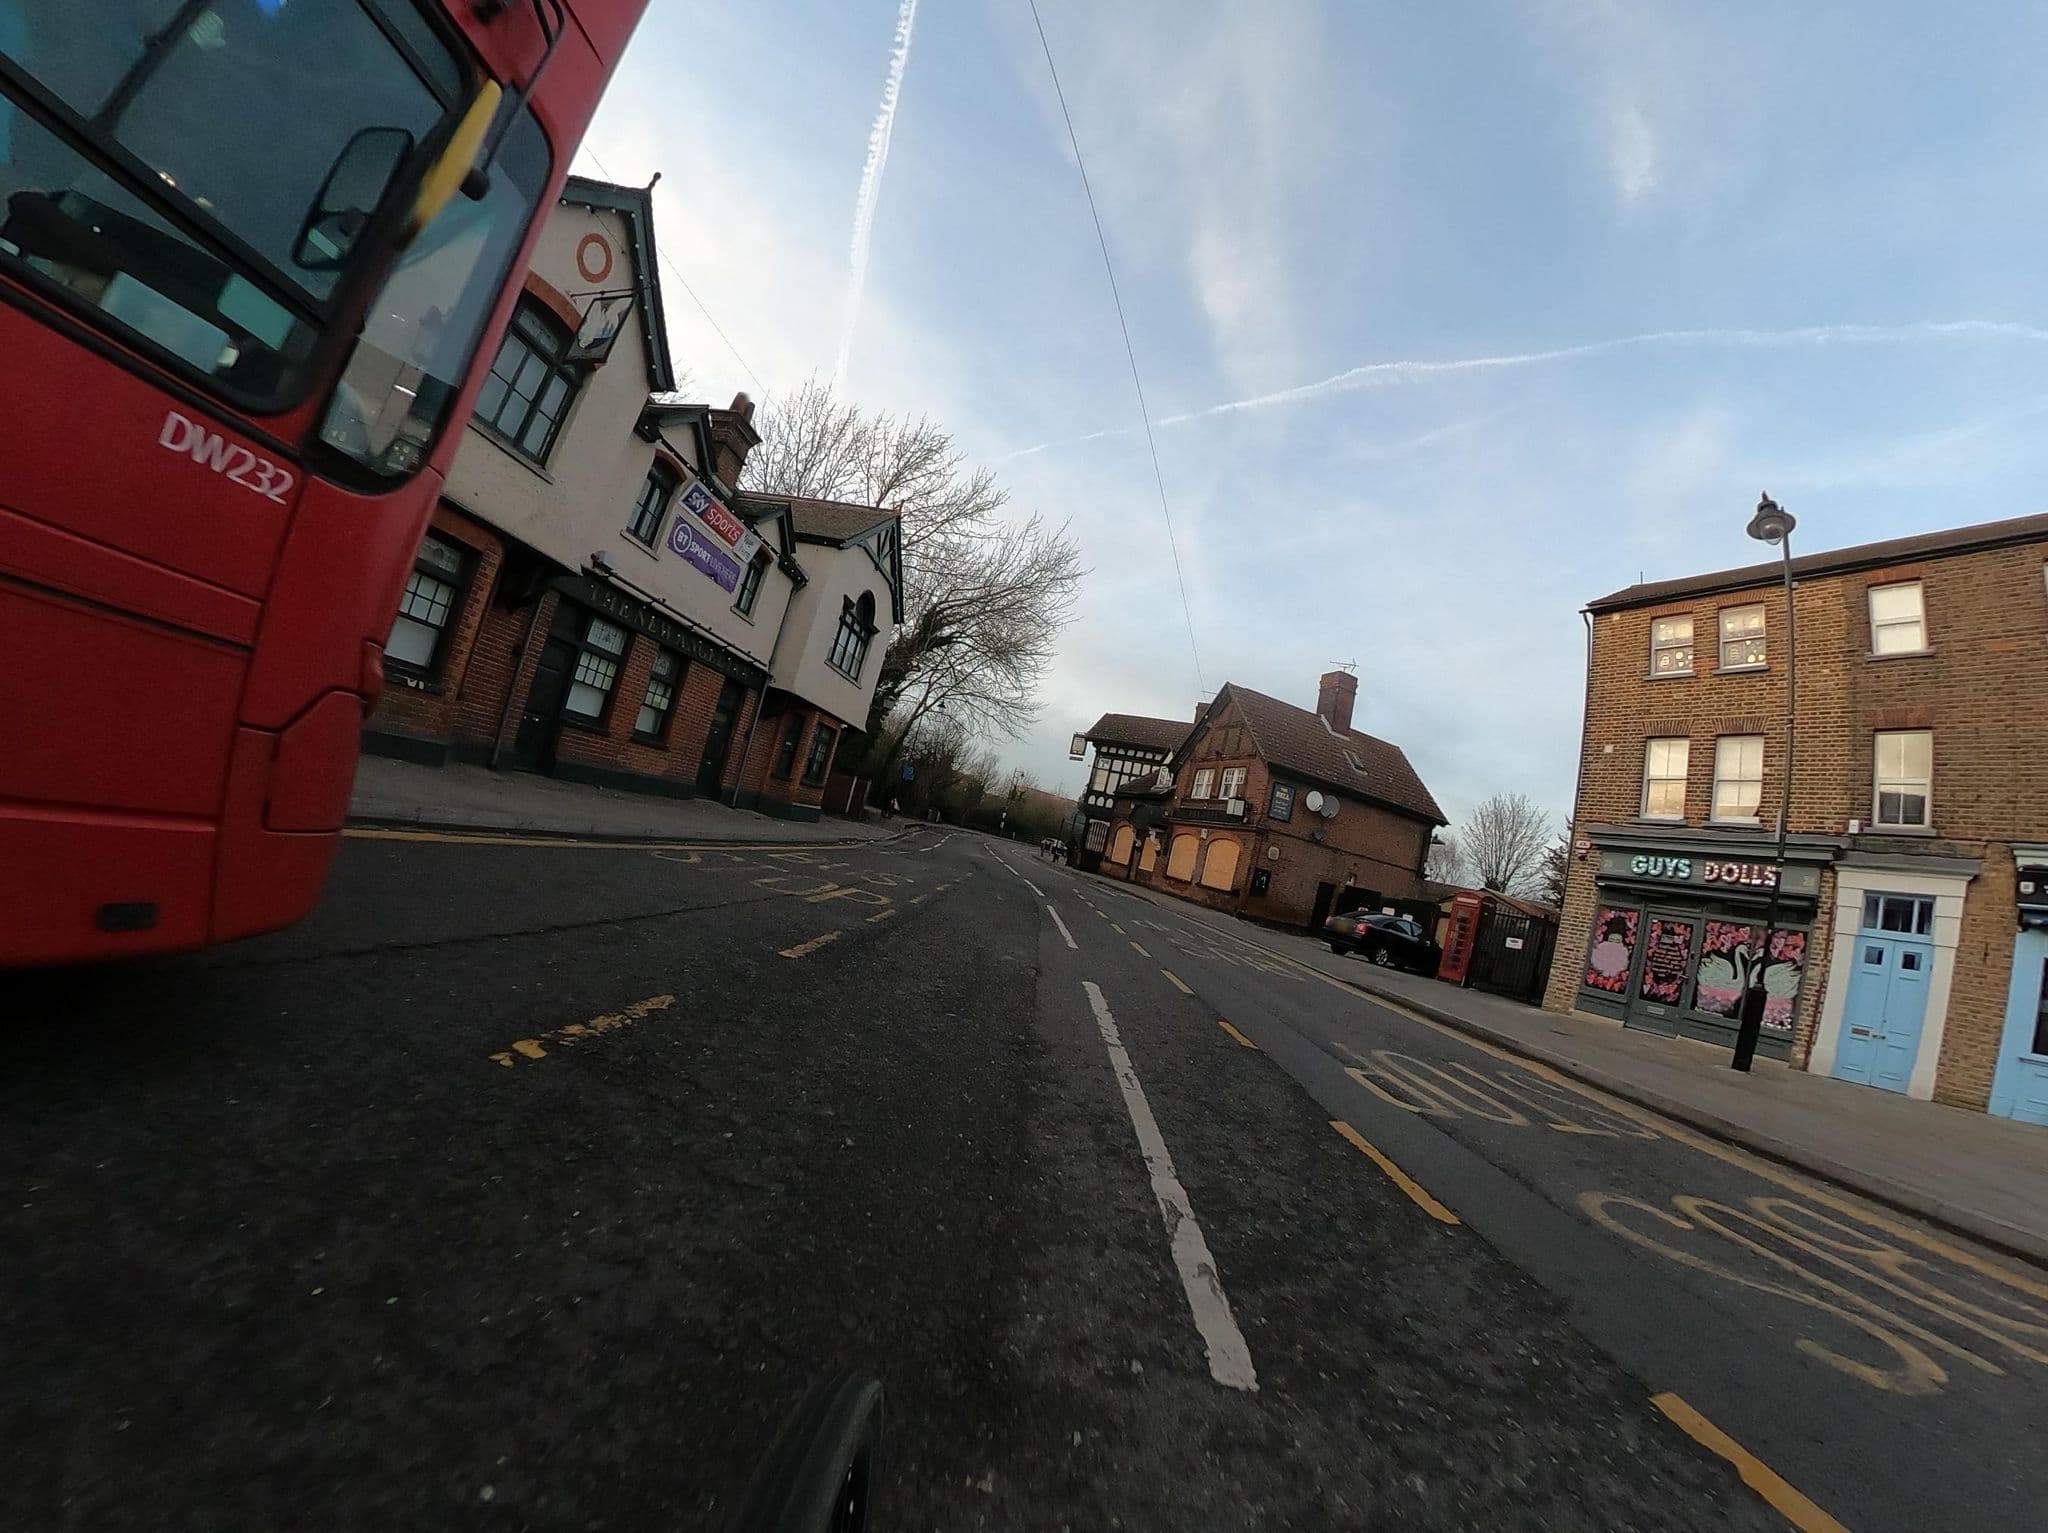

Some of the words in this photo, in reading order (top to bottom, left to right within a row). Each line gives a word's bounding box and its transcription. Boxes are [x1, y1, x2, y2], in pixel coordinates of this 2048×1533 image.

[159, 411, 294, 505] DW232
[687, 490, 710, 514] sky
[706, 508, 741, 542] sports
[676, 530, 689, 546] BT
[689, 541, 713, 565] SPORT
[1630, 855, 1692, 879] GUYS
[1703, 861, 1777, 887] DOLLS
